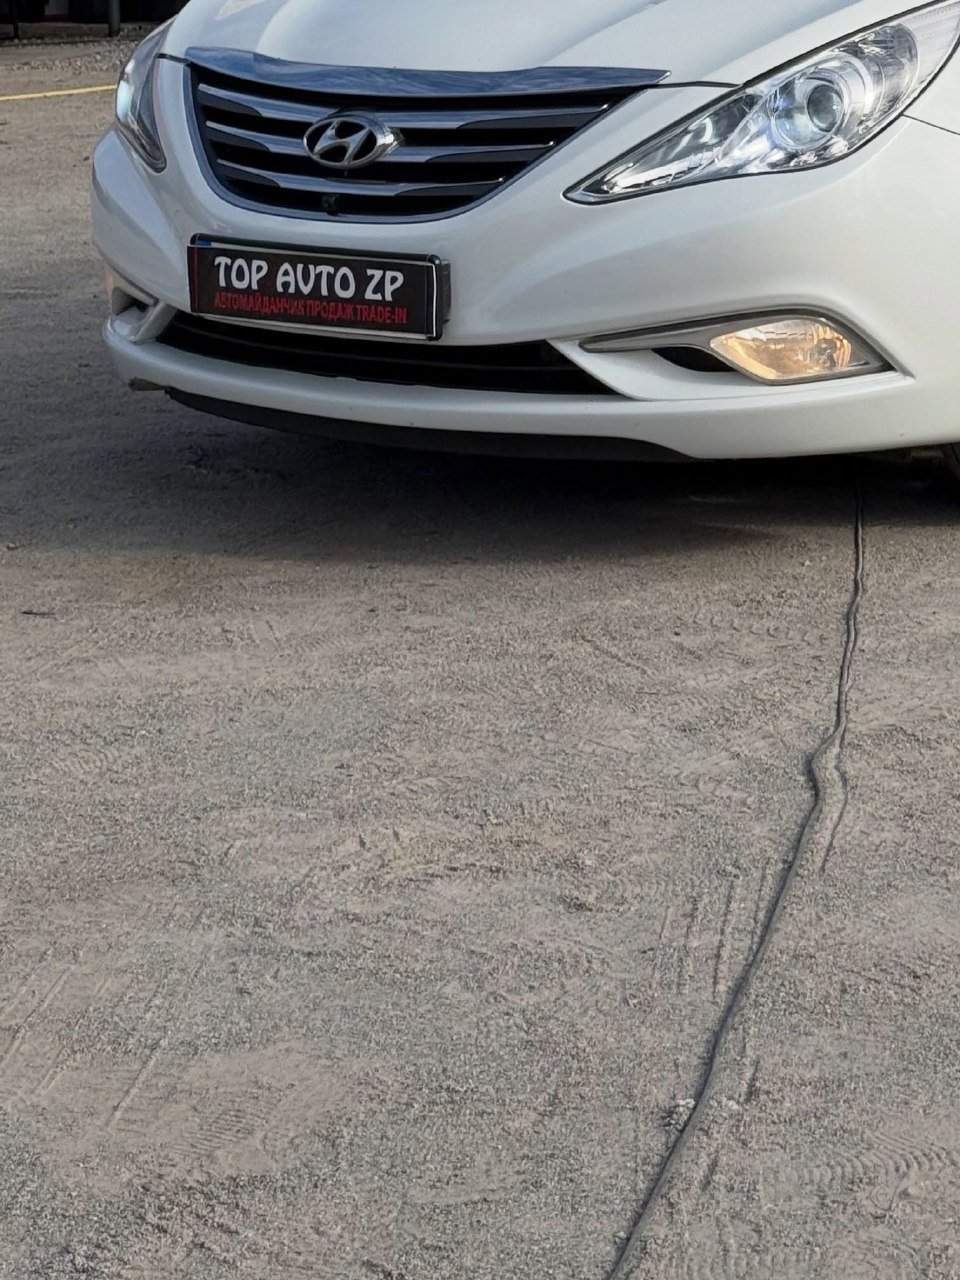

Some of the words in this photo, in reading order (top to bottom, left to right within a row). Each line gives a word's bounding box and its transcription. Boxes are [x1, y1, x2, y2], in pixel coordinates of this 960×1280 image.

[214, 256, 268, 290] TOP
[364, 269, 404, 301] ZP
[214, 291, 305, 316] АВТОМАЙДАНЧИК
[306, 300, 354, 321] ПРОДАЖ
[355, 304, 407, 324] TRADE-IN
